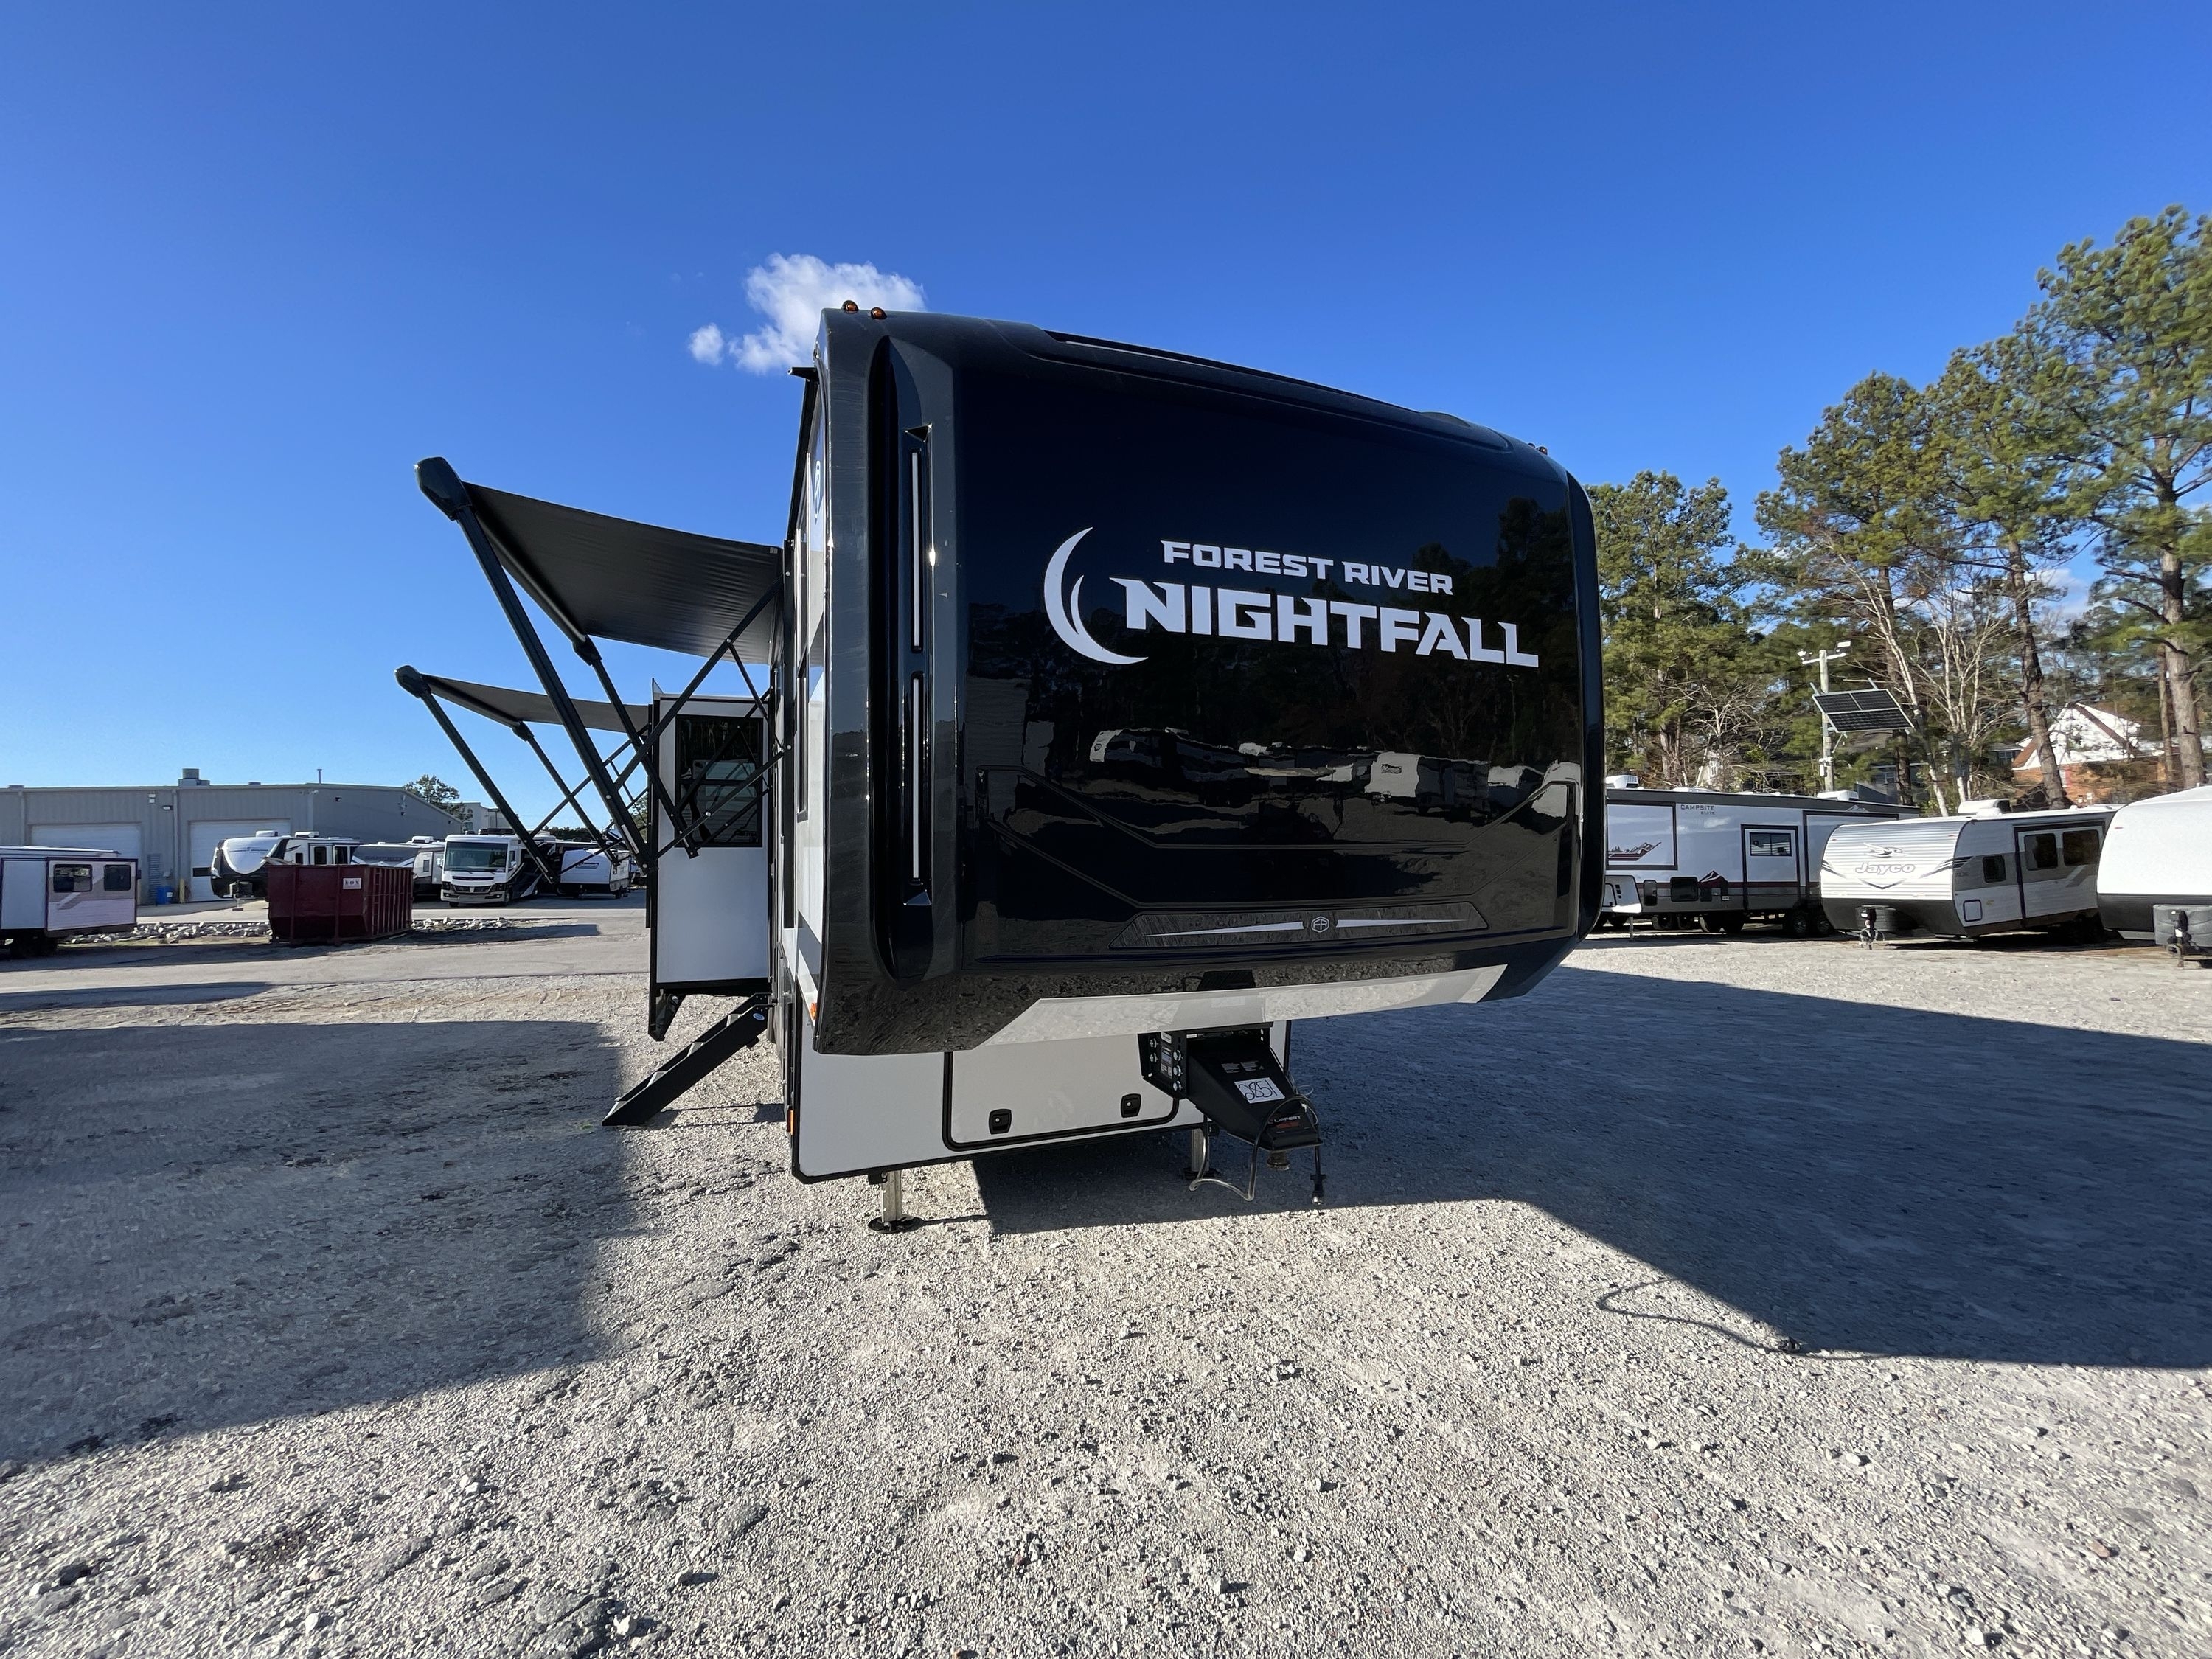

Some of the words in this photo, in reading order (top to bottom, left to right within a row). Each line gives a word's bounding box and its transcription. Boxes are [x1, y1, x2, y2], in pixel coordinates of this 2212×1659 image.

[1161, 540, 1333, 580] FOREST
[1342, 560, 1454, 596] RIVER
[1109, 577, 1539, 667] NIGHTFALL
[1855, 862, 1916, 875] Jayco
[1239, 1079, 1278, 1101] 2851
